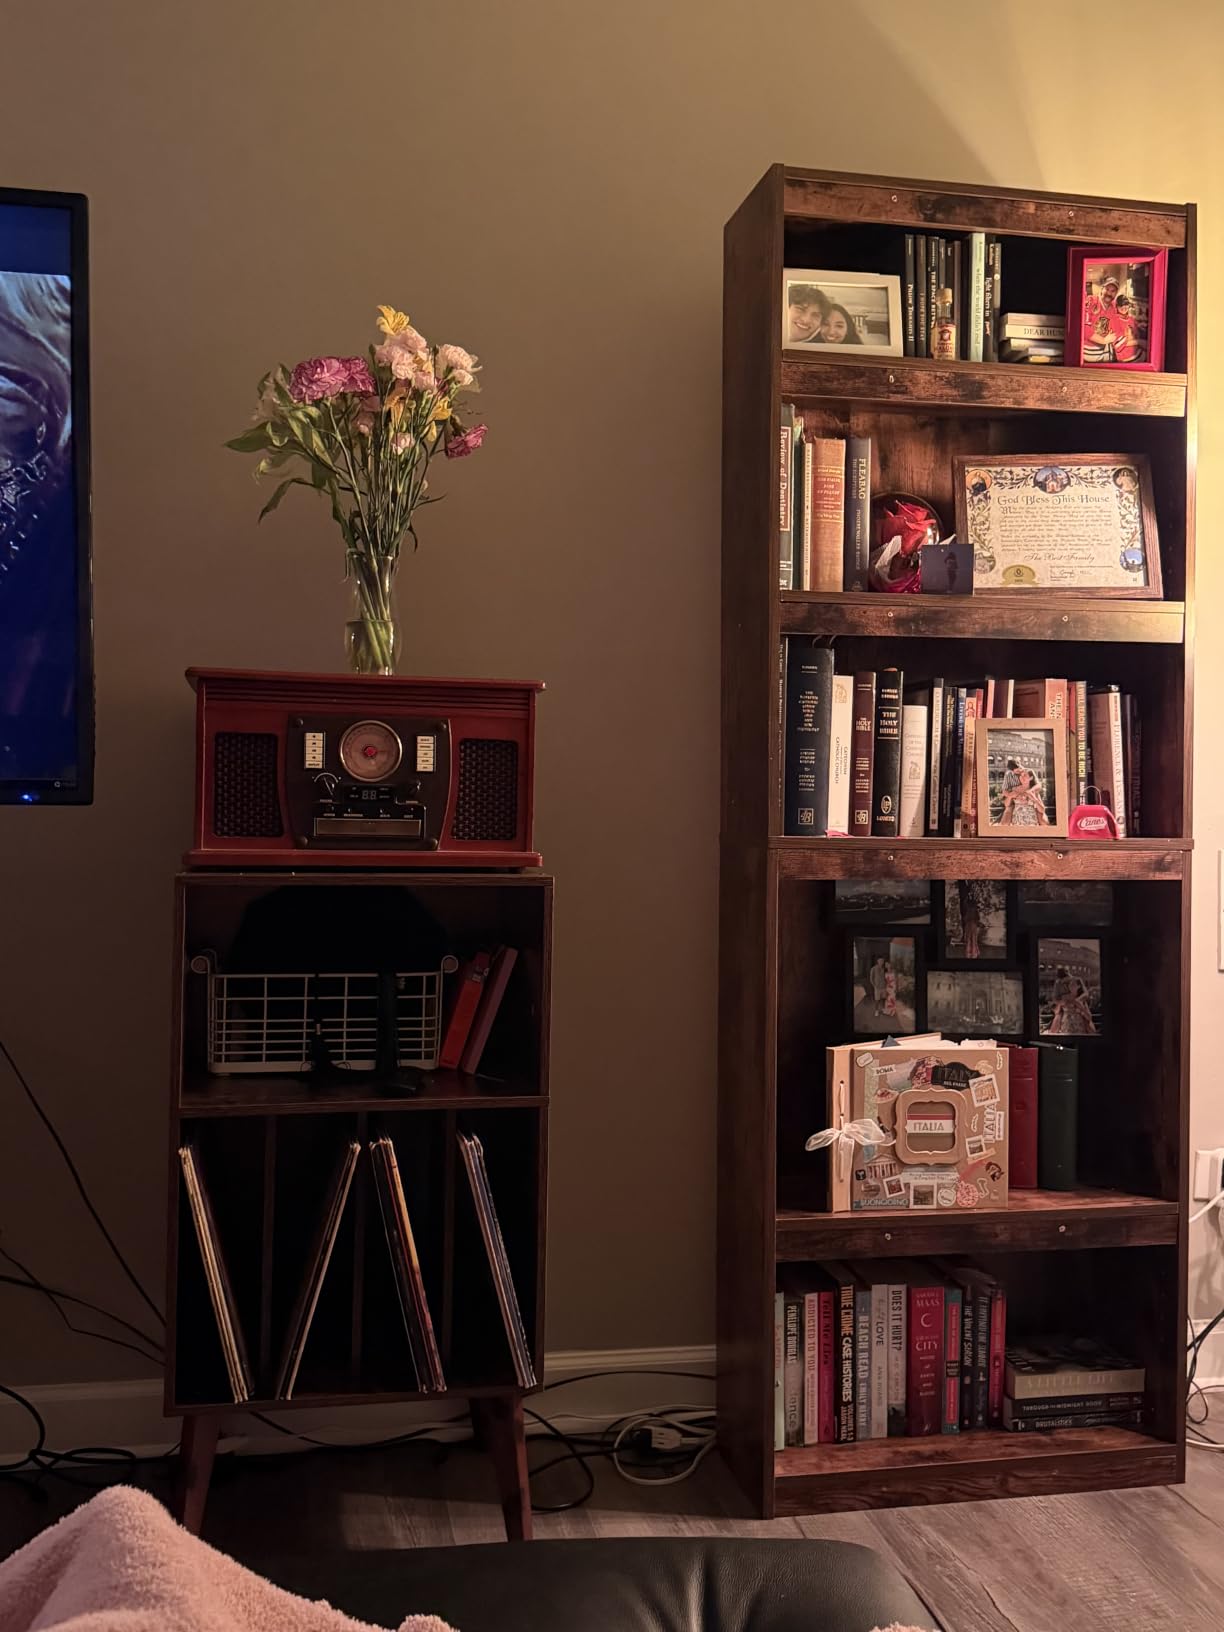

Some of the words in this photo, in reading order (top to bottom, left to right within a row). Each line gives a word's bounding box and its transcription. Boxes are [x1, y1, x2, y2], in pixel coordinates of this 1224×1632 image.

[984, 277, 993, 291] light
[1023, 328, 1046, 337] DEAR
[779, 432, 788, 465] Review
[779, 468, 788, 478] of
[858, 458, 866, 499] FLEABAG
[778, 482, 788, 526] Dentistry
[997, 495, 1019, 506] God
[1021, 494, 1050, 506] Bless
[1052, 494, 1075, 505] This
[1077, 494, 1110, 504] House
[1063, 553, 1095, 563] Family
[1078, 688, 1086, 705] WILL
[1078, 706, 1086, 726] TEACH
[1078, 727, 1086, 740] YOU
[1079, 742, 1086, 750] TO
[1079, 751, 1086, 760] BE
[1113, 724, 1121, 767] FLORENCE
[876, 1066, 894, 1074] ROMA
[913, 1122, 945, 1131] ITALIA
[840, 1285, 854, 1308] TRUE
[891, 1290, 903, 1311] DOES
[915, 1299, 940, 1307] MAAS
[787, 1305, 798, 1335] PENELOPE
[806, 1299, 816, 1341] ADDICTED
[891, 1313, 903, 1322] IT
[964, 1305, 973, 1316] THE
[823, 1322, 831, 1339] Me
[840, 1309, 854, 1336] CRIME
[858, 1315, 869, 1349] BEACH
[875, 1321, 885, 1346] LOVE
[891, 1325, 903, 1351] HURT?
[787, 1336, 798, 1364] DOUGLAS
[807, 1343, 815, 1353] TO
[822, 1343, 831, 1365] Lies
[841, 1336, 853, 1359] CASE
[915, 1341, 938, 1352] CITY
[963, 1342, 973, 1366] SEASON
[806, 1354, 815, 1370] YOU
[858, 1352, 869, 1378] READ
[841, 1359, 853, 1402] HISTORIES
[859, 1382, 868, 1403] EMILY
[858, 1404, 867, 1426] HENRY
[1023, 1404, 1048, 1412] THROUGH
